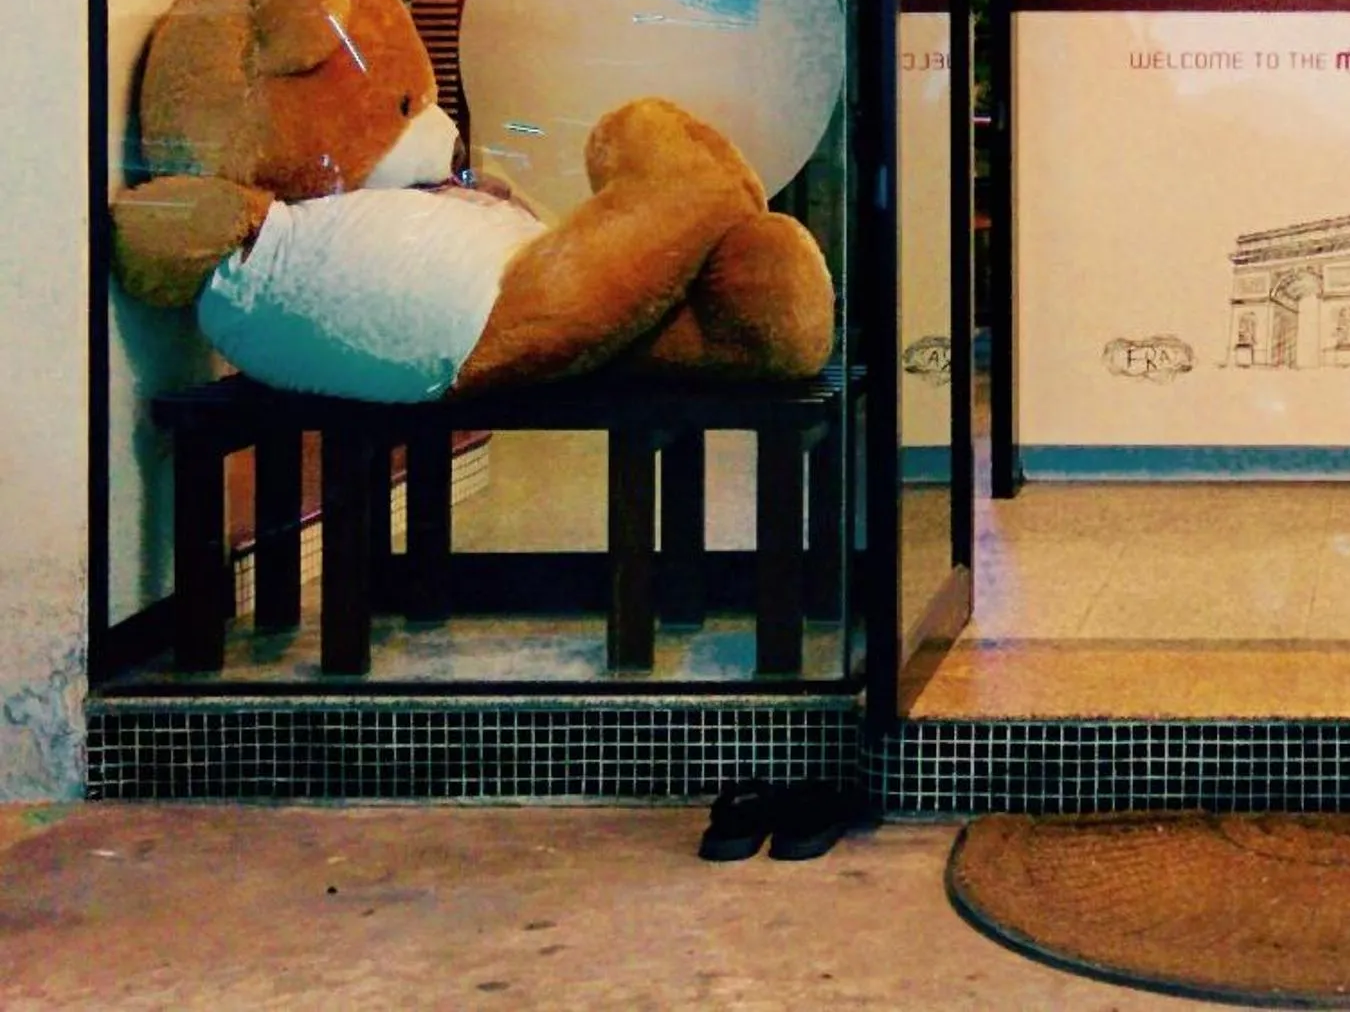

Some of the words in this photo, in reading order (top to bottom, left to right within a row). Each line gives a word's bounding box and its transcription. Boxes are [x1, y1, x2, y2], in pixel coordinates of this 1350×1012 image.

[1129, 51, 1244, 70] WELCOME
[1254, 51, 1280, 70] TO
[1289, 51, 1327, 70] THE
